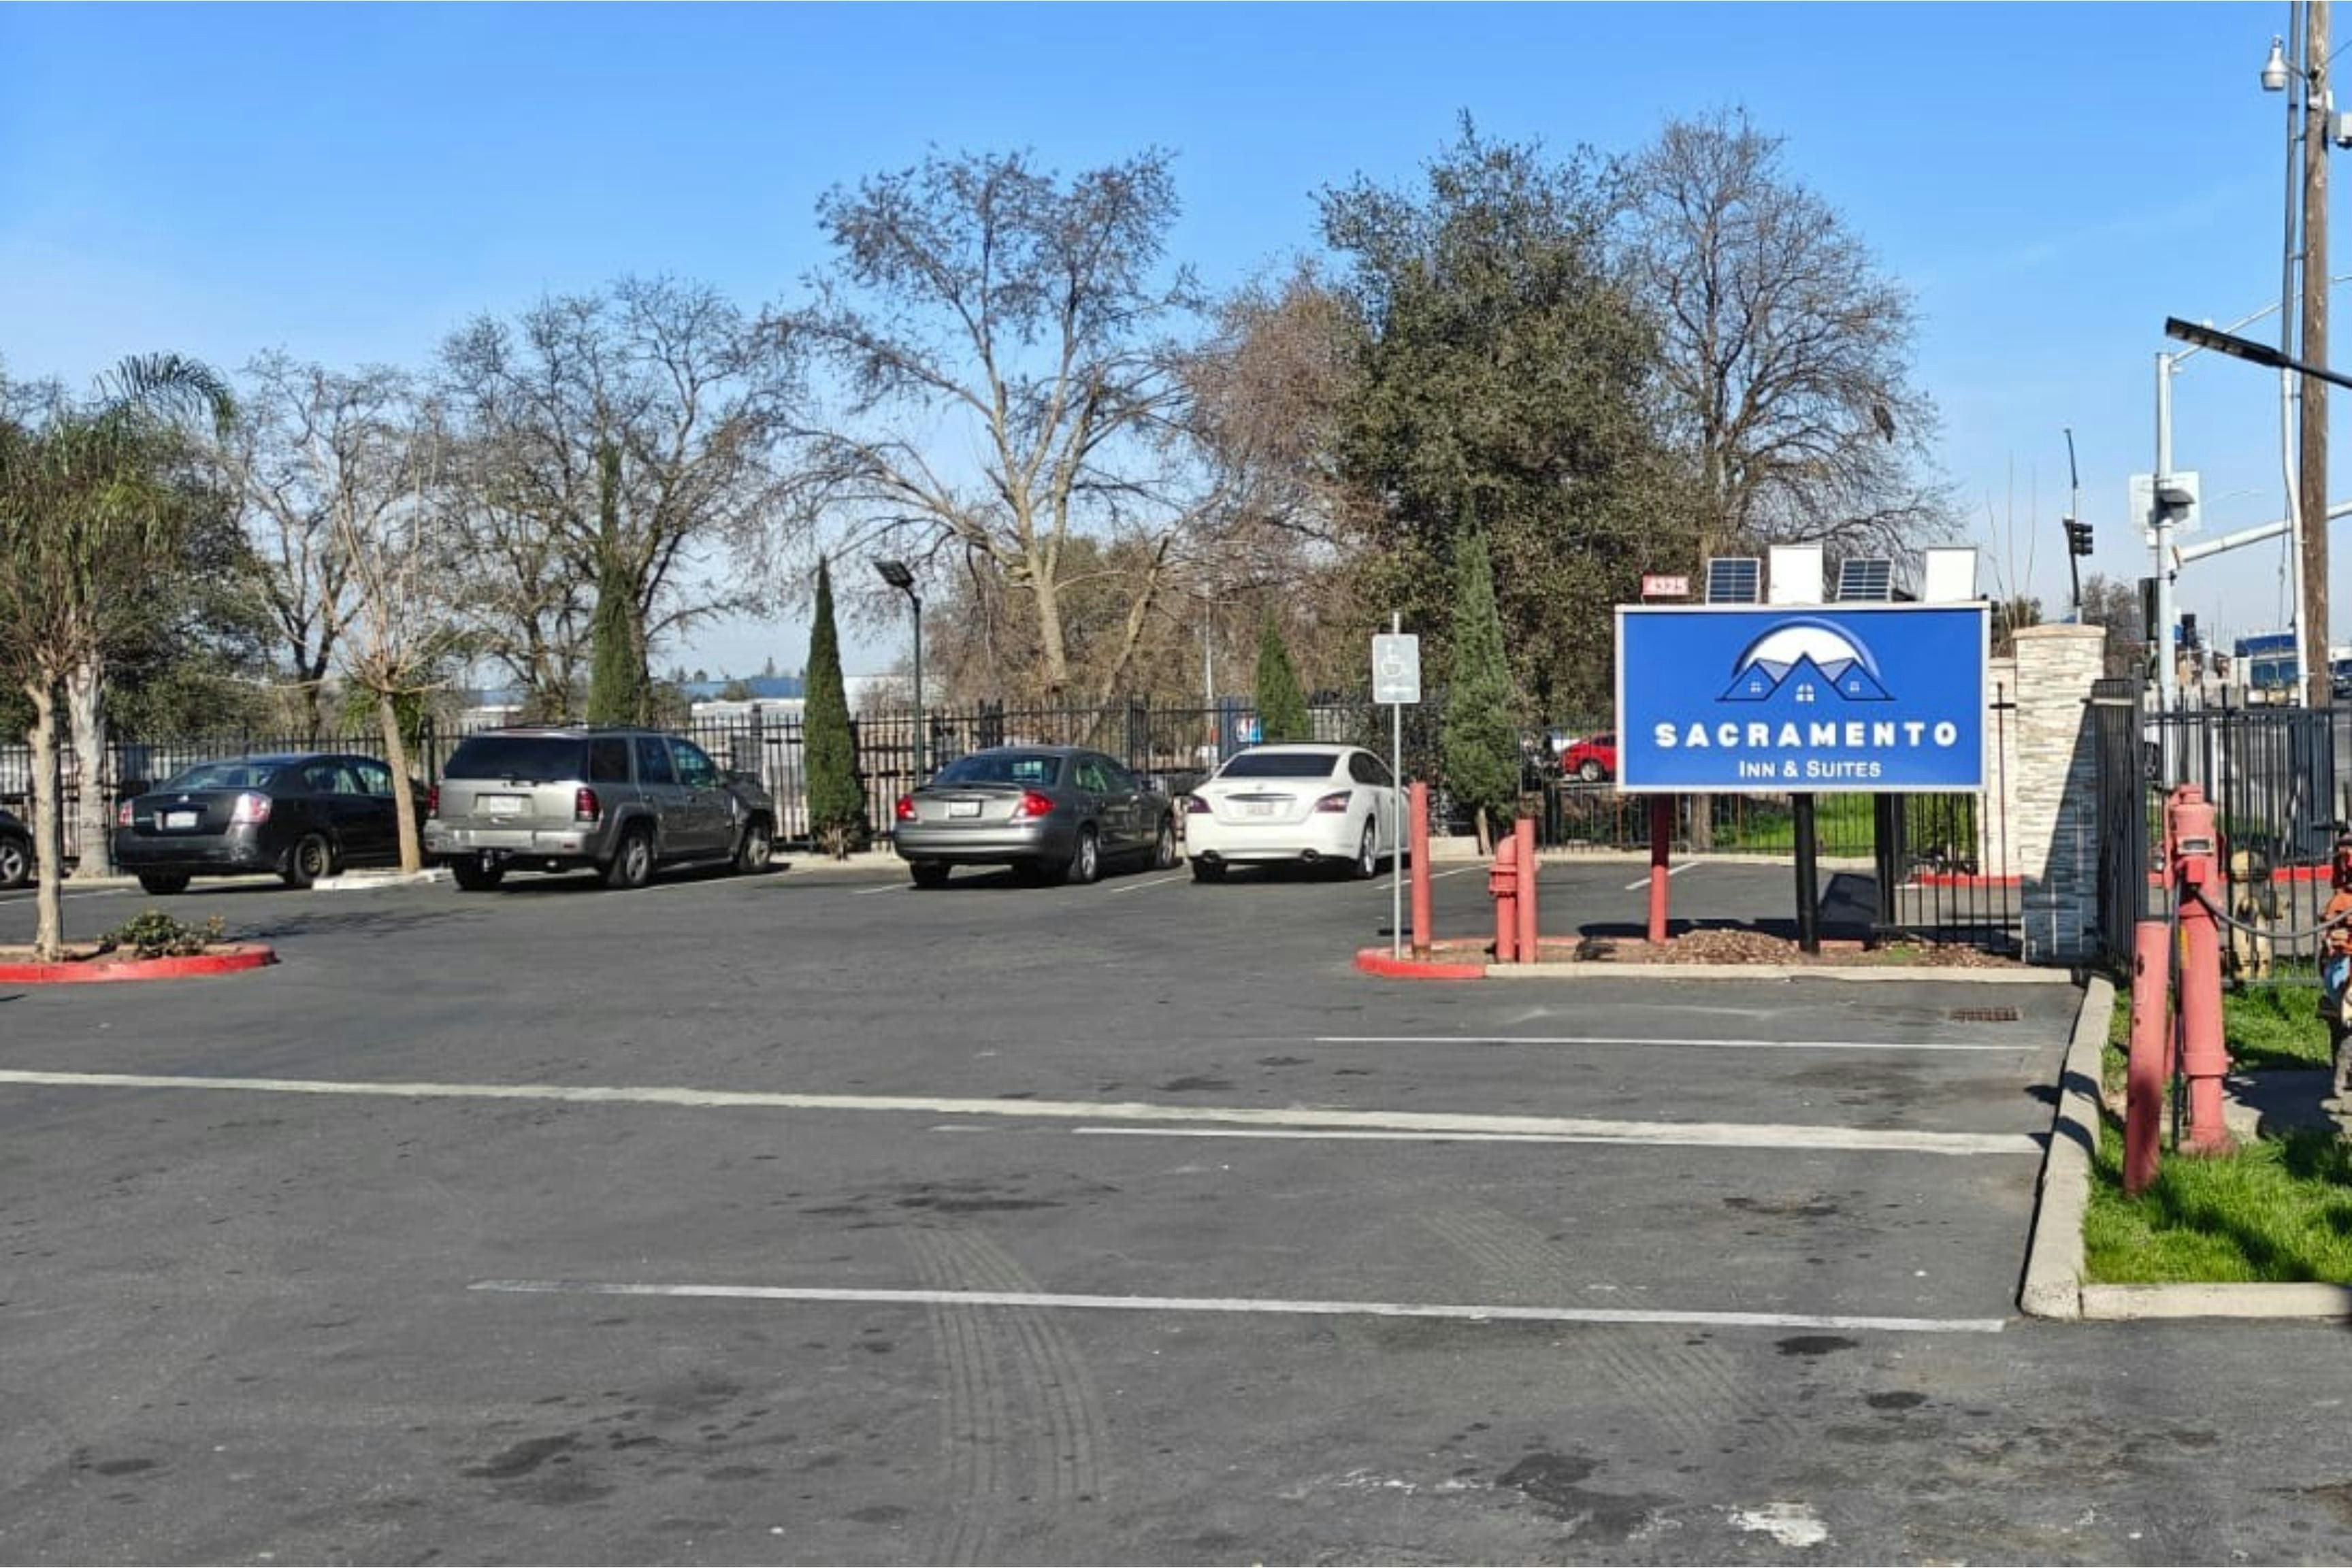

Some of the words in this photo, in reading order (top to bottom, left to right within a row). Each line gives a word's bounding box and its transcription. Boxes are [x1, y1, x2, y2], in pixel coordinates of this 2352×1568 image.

[1655, 722, 1957, 747] SACRAMENTO
[1740, 760, 1776, 778] INN
[1782, 760, 1799, 778] &
[1806, 760, 1882, 778] SUITES
